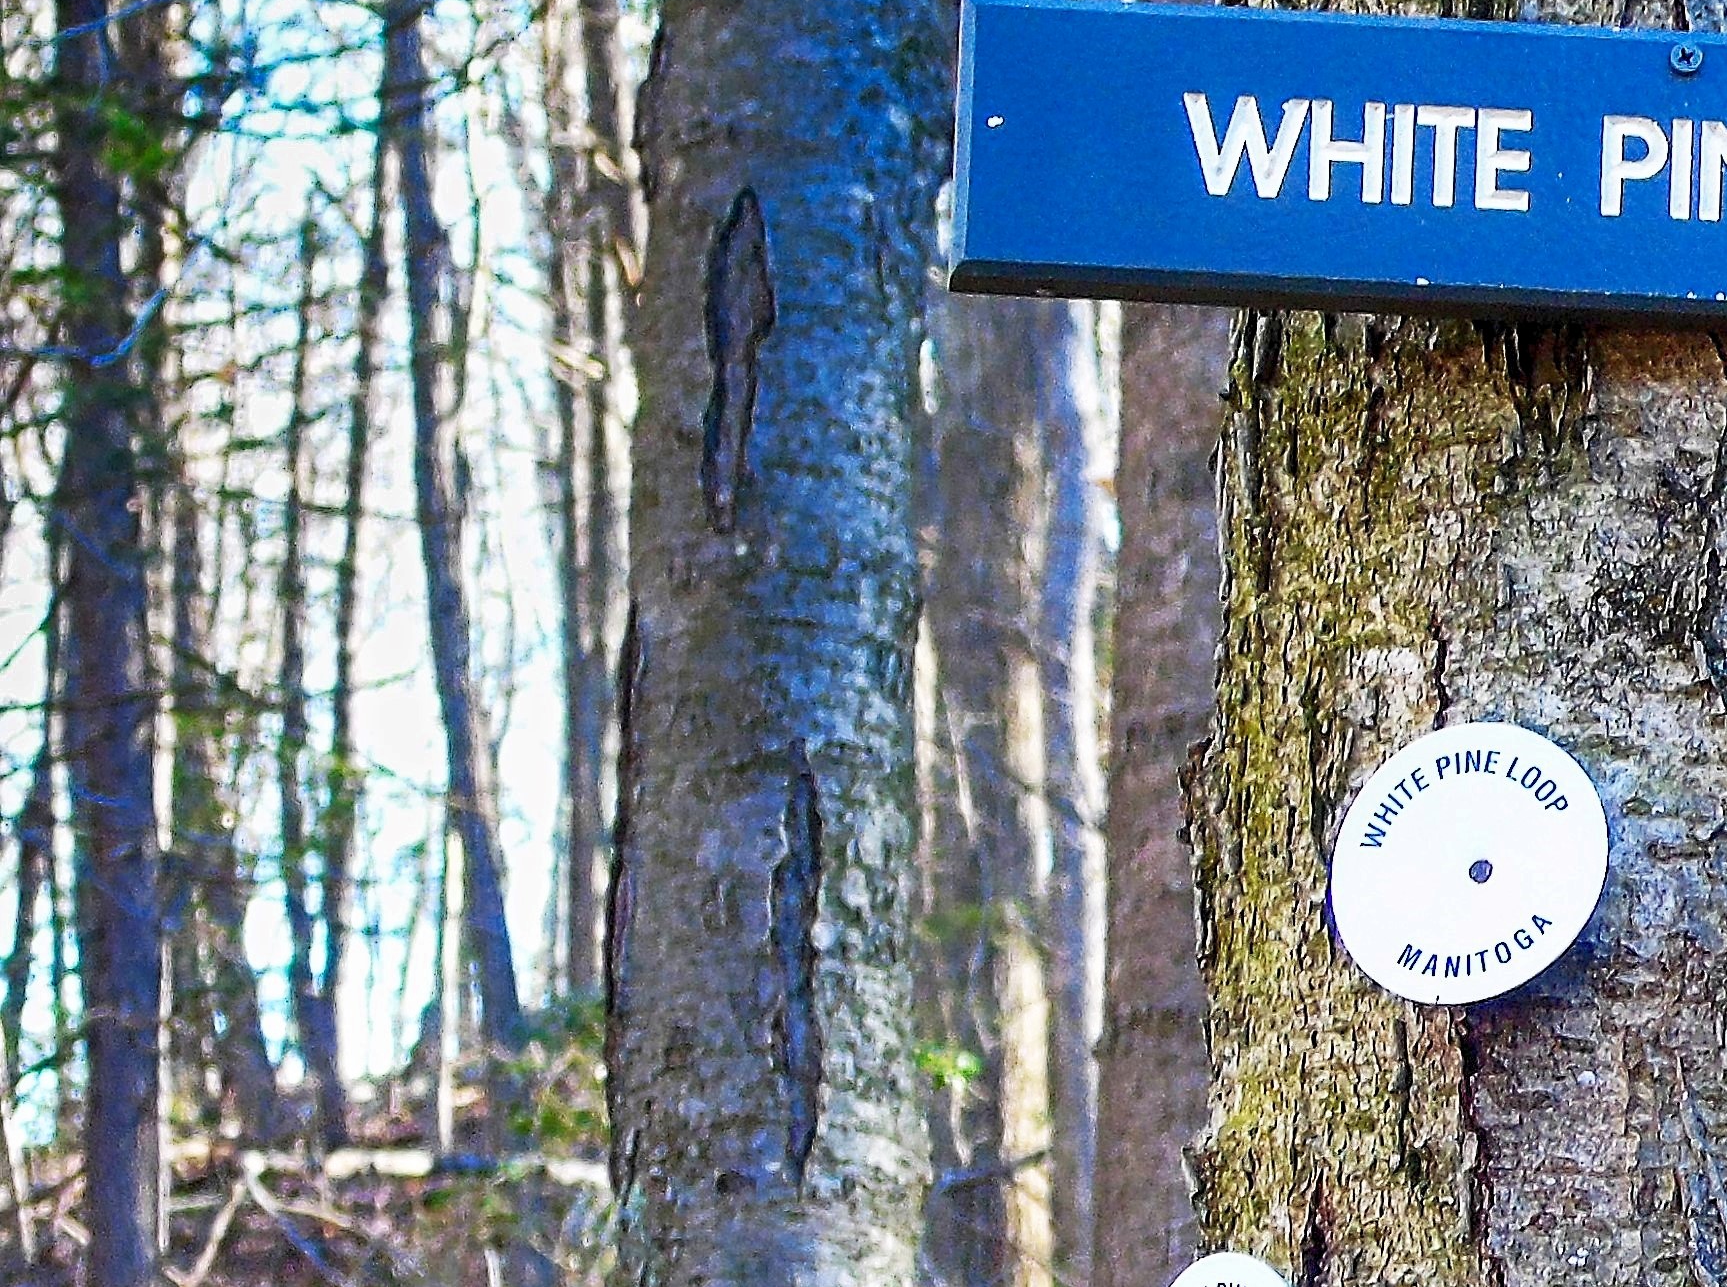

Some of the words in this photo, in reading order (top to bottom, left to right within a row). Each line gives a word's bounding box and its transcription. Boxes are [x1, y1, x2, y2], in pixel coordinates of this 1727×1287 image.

[1183, 92, 1532, 212] WHITE
[1359, 767, 1430, 848] WHITE
[1435, 749, 1501, 781] PINE
[1505, 756, 1569, 811] LOOP
[1396, 914, 1553, 979] MANITOGA
